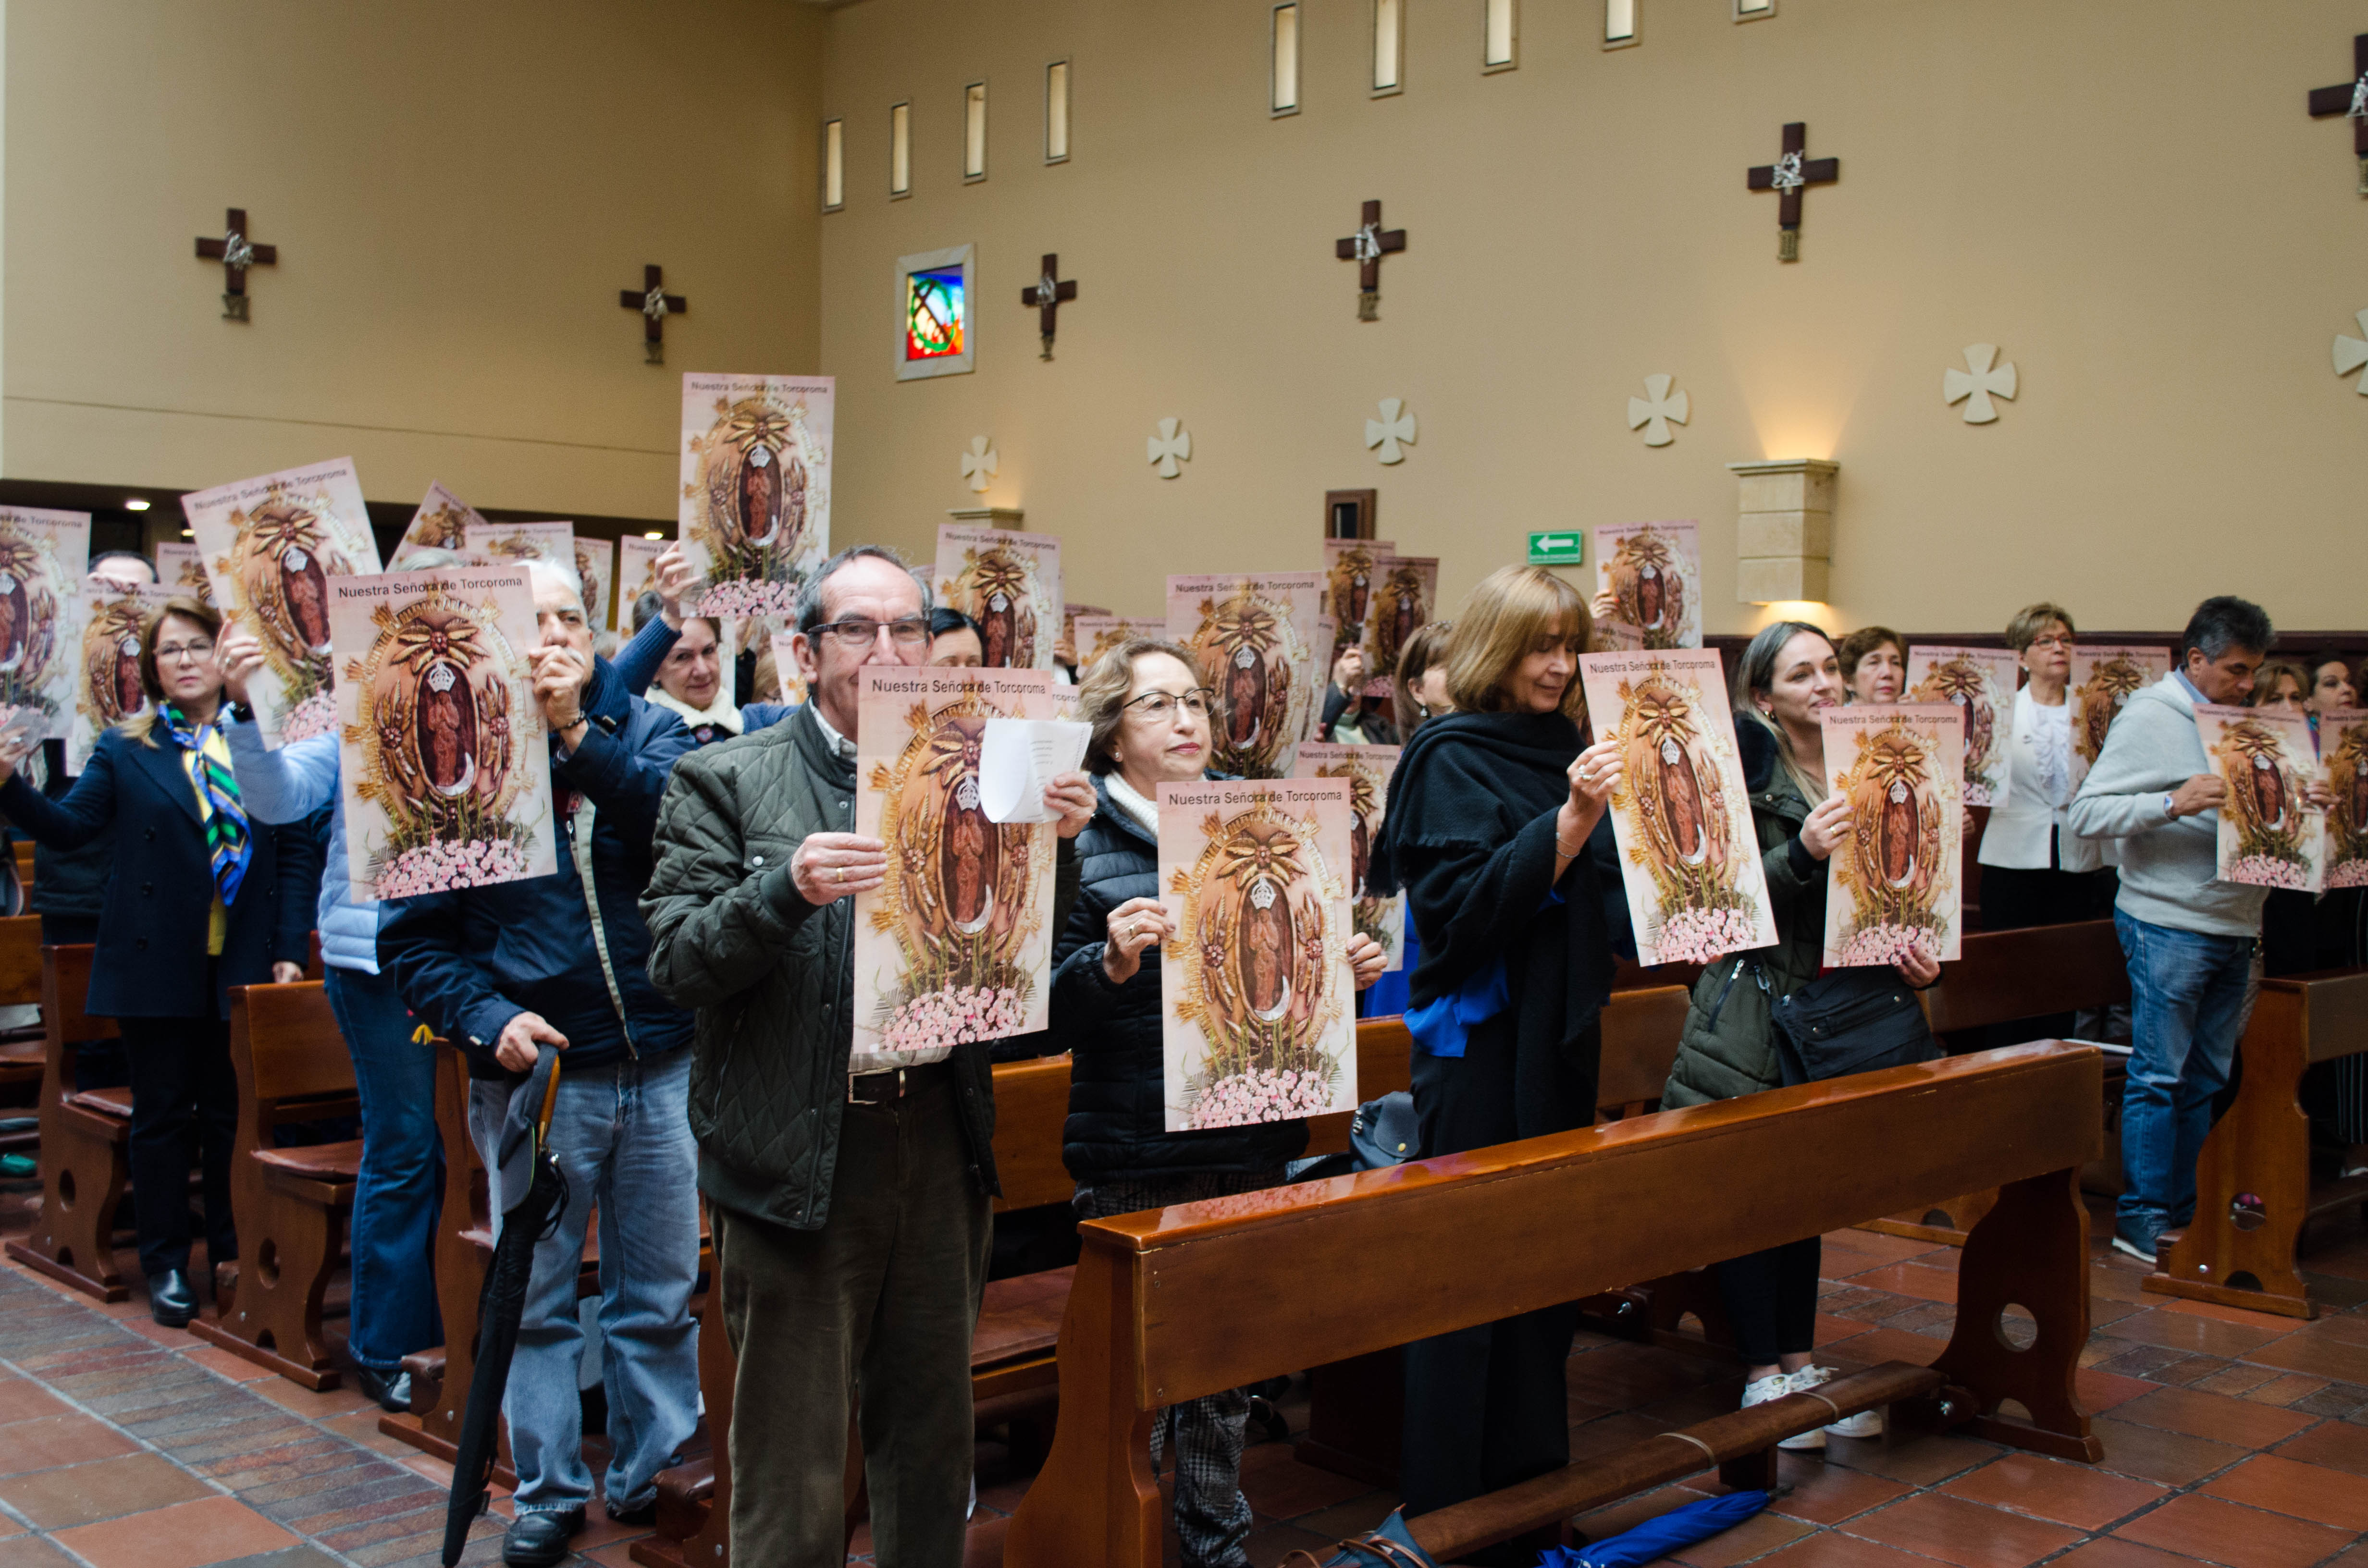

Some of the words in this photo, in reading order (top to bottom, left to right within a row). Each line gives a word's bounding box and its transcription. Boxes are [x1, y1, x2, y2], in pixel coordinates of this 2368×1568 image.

[691, 381, 728, 391] Nuestra
[782, 384, 827, 393] Torcoroma
[195, 494, 238, 511] Nuestra
[295, 469, 347, 485] Torcoroma
[31, 515, 82, 527] Torcoroma
[946, 532, 977, 542] Nuestra
[1020, 539, 1055, 550] Torcoroma
[339, 585, 389, 598] Nuestra
[394, 582, 437, 594] Señora
[440, 579, 456, 591] de
[460, 577, 522, 589] Torcoroma
[1176, 584, 1213, 593] Nuestra
[1267, 581, 1314, 590] Torcoroma
[1590, 663, 1626, 673] Nuestra
[1629, 661, 1658, 671] Señora
[1661, 660, 1670, 670] de
[1672, 660, 1715, 669] Torcoroma
[872, 679, 927, 693] Nuestra
[933, 679, 974, 693] Señora
[978, 681, 991, 693] de
[995, 681, 1046, 694] Torcoroma
[1829, 715, 1866, 724] Nuestra
[1869, 714, 1900, 724] Señora
[1902, 715, 1912, 724] de
[1914, 714, 1957, 724] Torcoroma
[1299, 750, 1327, 759] Nuestra
[1365, 752, 1397, 760] Torcoroma
[1169, 793, 1220, 806] Nuestra
[1224, 792, 1265, 804] Señora
[1269, 791, 1283, 802] de
[1286, 790, 1342, 801] Torcoroma
